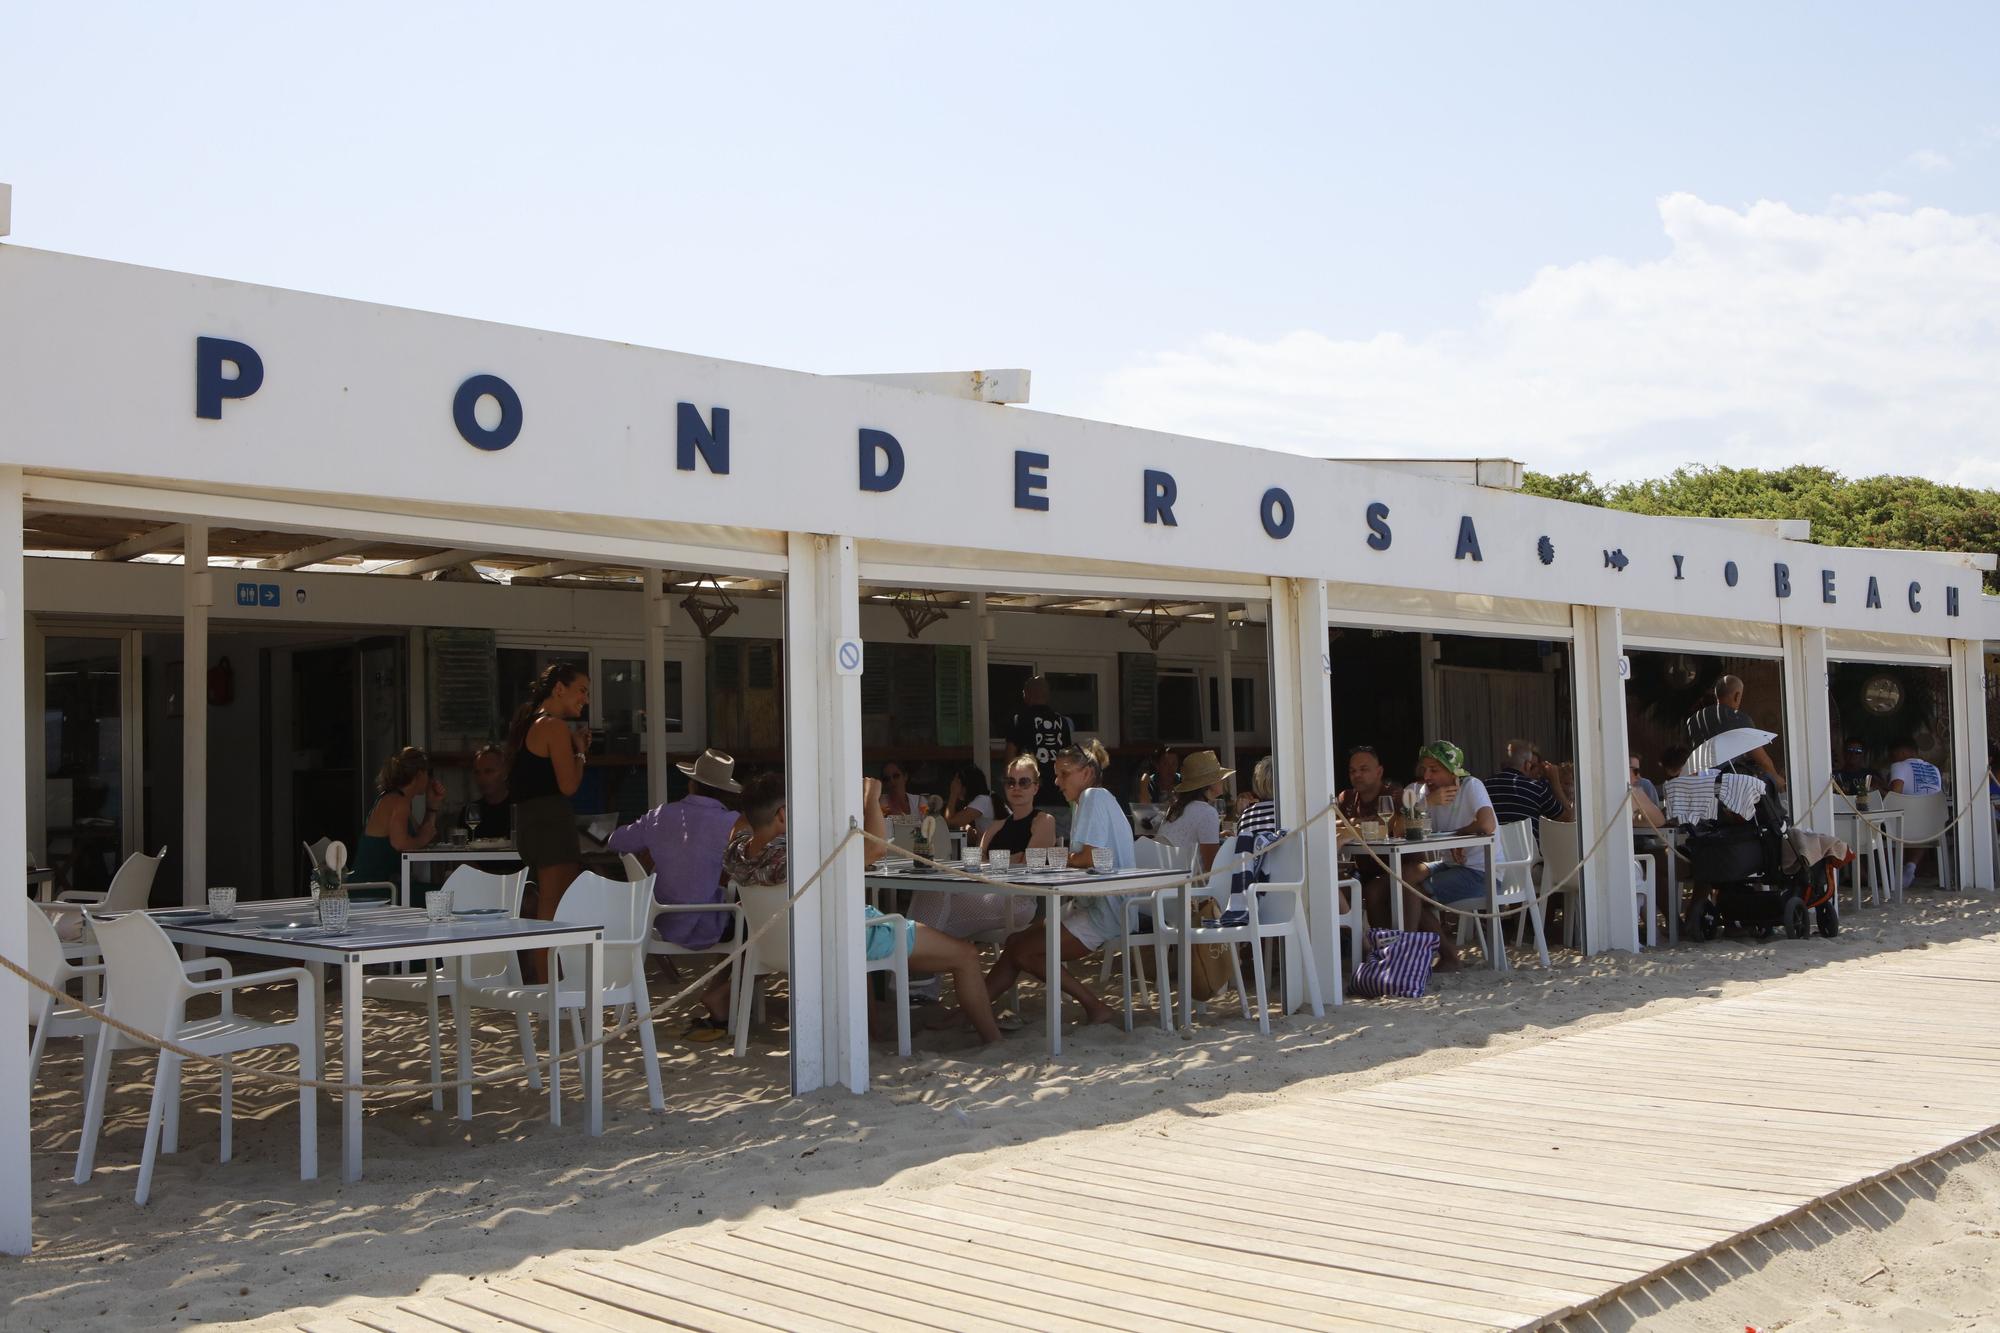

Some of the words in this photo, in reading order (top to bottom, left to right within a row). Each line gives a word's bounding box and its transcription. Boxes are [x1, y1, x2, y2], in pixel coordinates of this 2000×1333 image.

[196, 336, 1482, 561] PONDEROSA
[1034, 716, 1063, 730] PON
[1036, 747, 1057, 763] OS
